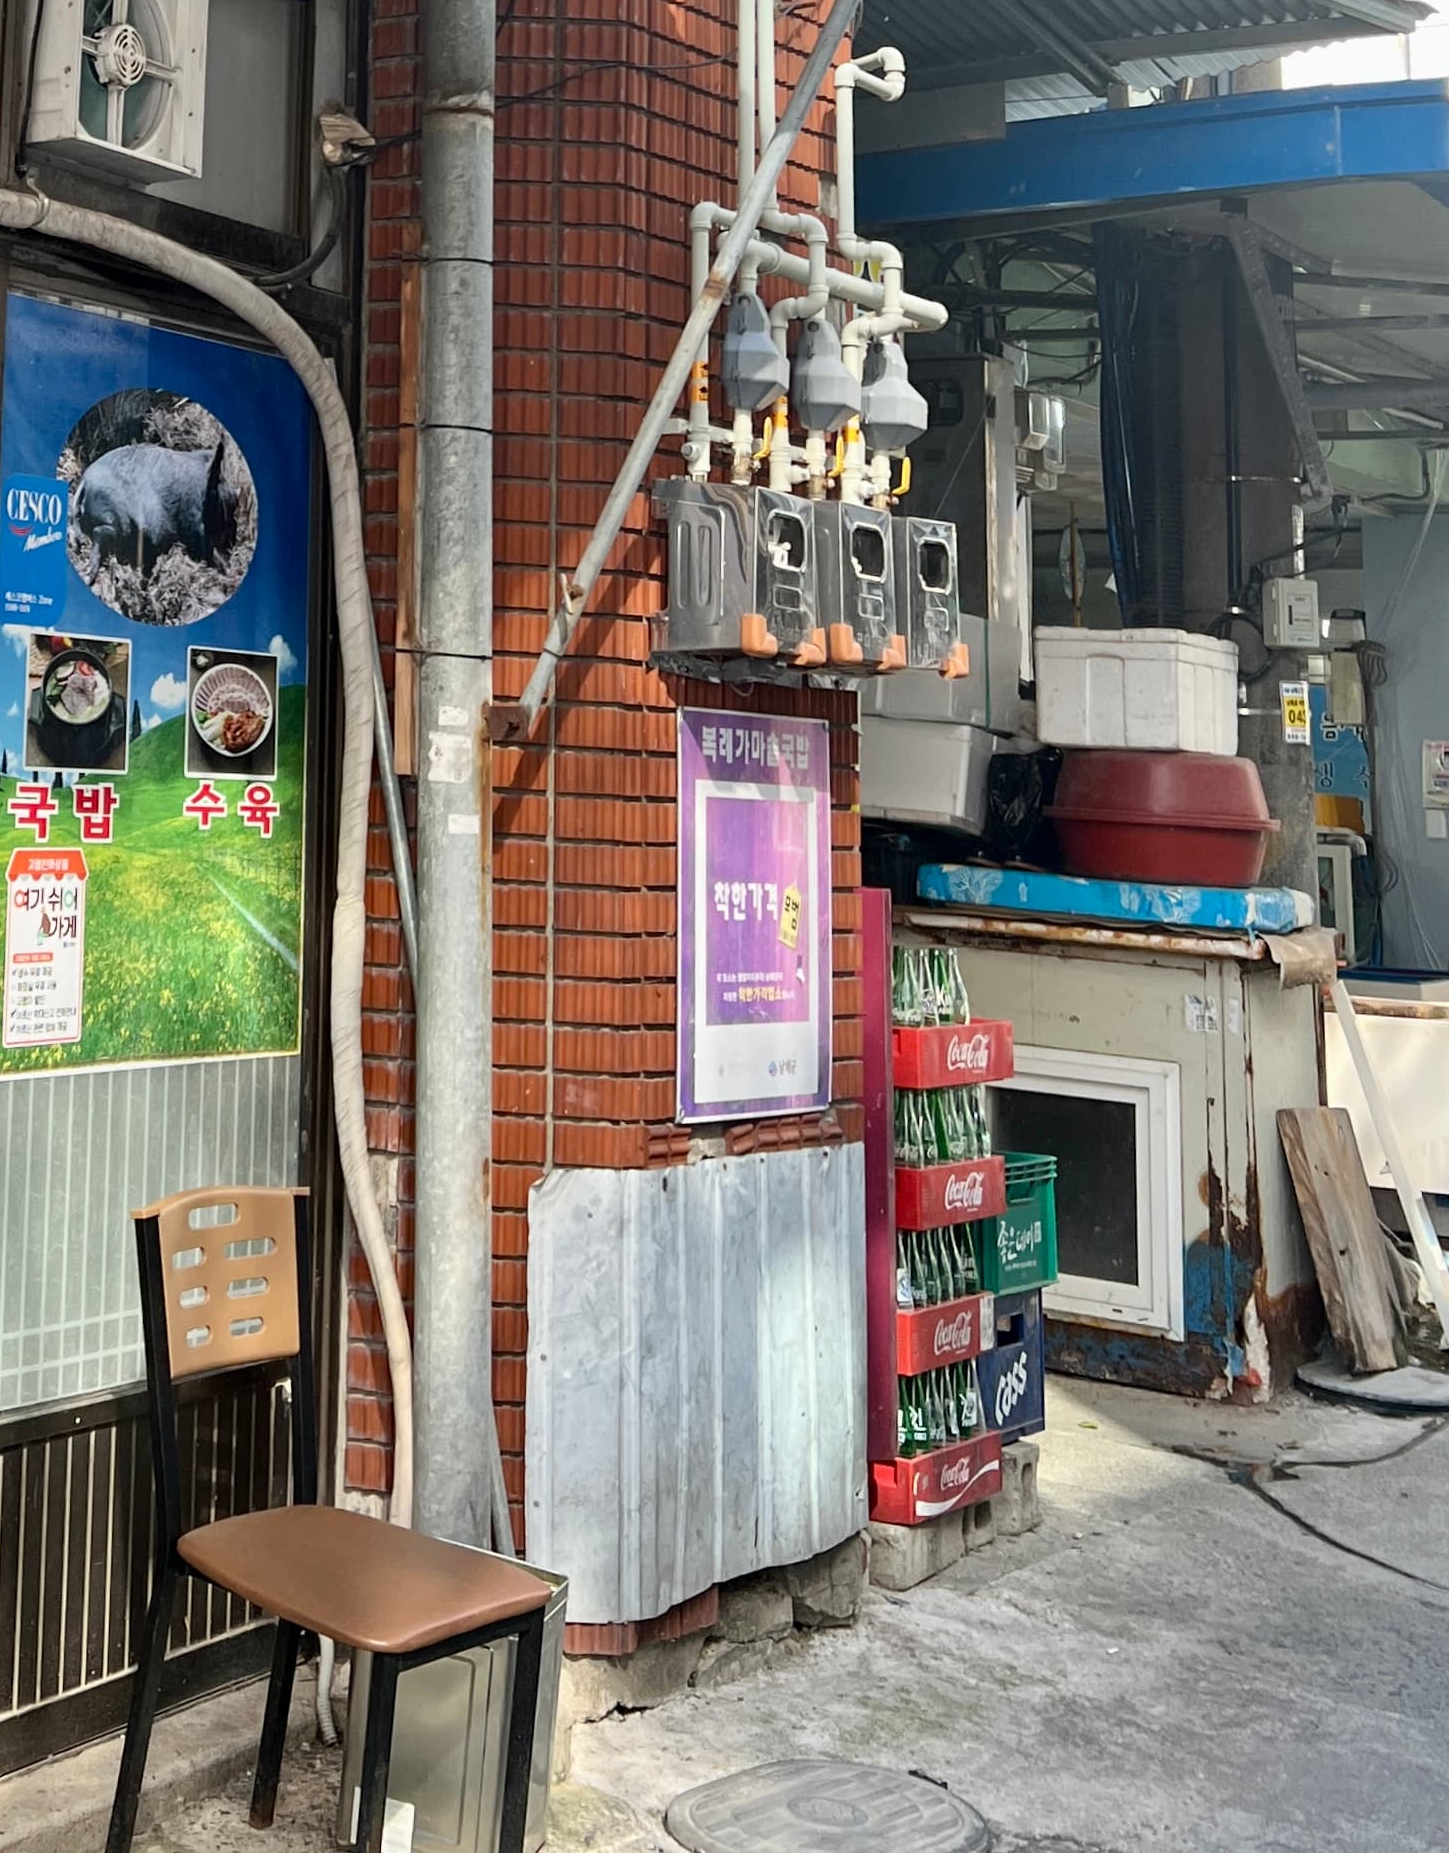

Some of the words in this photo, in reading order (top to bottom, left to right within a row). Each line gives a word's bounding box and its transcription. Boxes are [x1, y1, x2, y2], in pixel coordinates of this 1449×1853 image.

[6, 487, 63, 526] CESCO
[7, 781, 119, 843] 국밥
[183, 780, 280, 839] 수육
[713, 881, 778, 922] 착한가격
[42, 915, 78, 940] 가게
